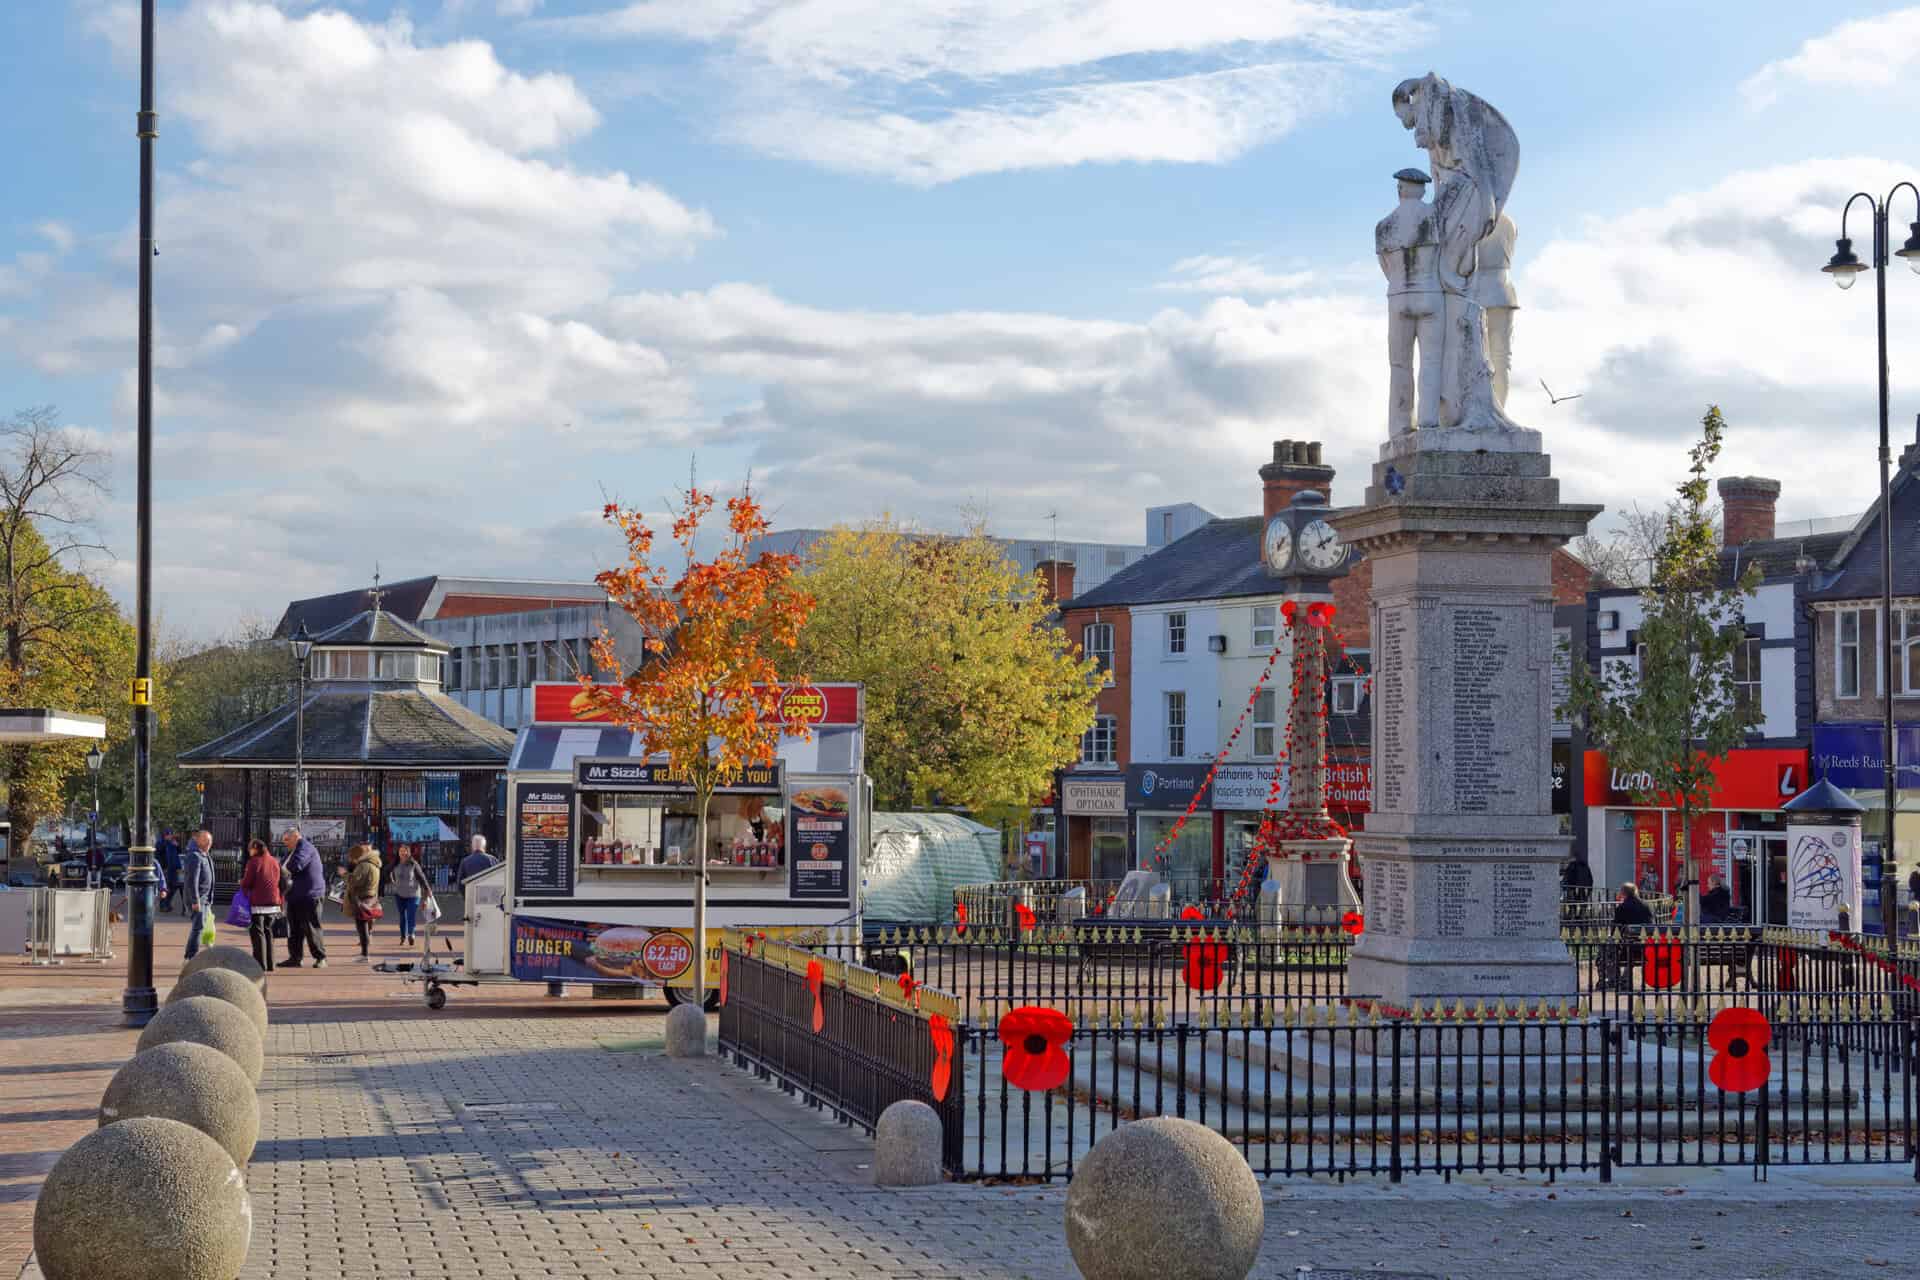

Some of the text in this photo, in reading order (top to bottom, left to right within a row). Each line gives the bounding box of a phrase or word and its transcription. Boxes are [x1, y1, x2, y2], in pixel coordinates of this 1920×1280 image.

[132, 681, 148, 702] H
[783, 706, 821, 717] FOOD
[1831, 753, 1860, 769] Reeds
[589, 766, 648, 778] Mr Sizzle
[746, 769, 773, 784] YOU!
[1325, 766, 1363, 783] British
[1158, 777, 1195, 790] Portland
[1070, 786, 1121, 798] OPHTHALMIC
[1246, 783, 1265, 800] shop
[1076, 799, 1115, 810] OPTICIAN
[516, 938, 573, 956] BURGER
[647, 945, 687, 962] £2.50
[658, 961, 676, 972] EACH
